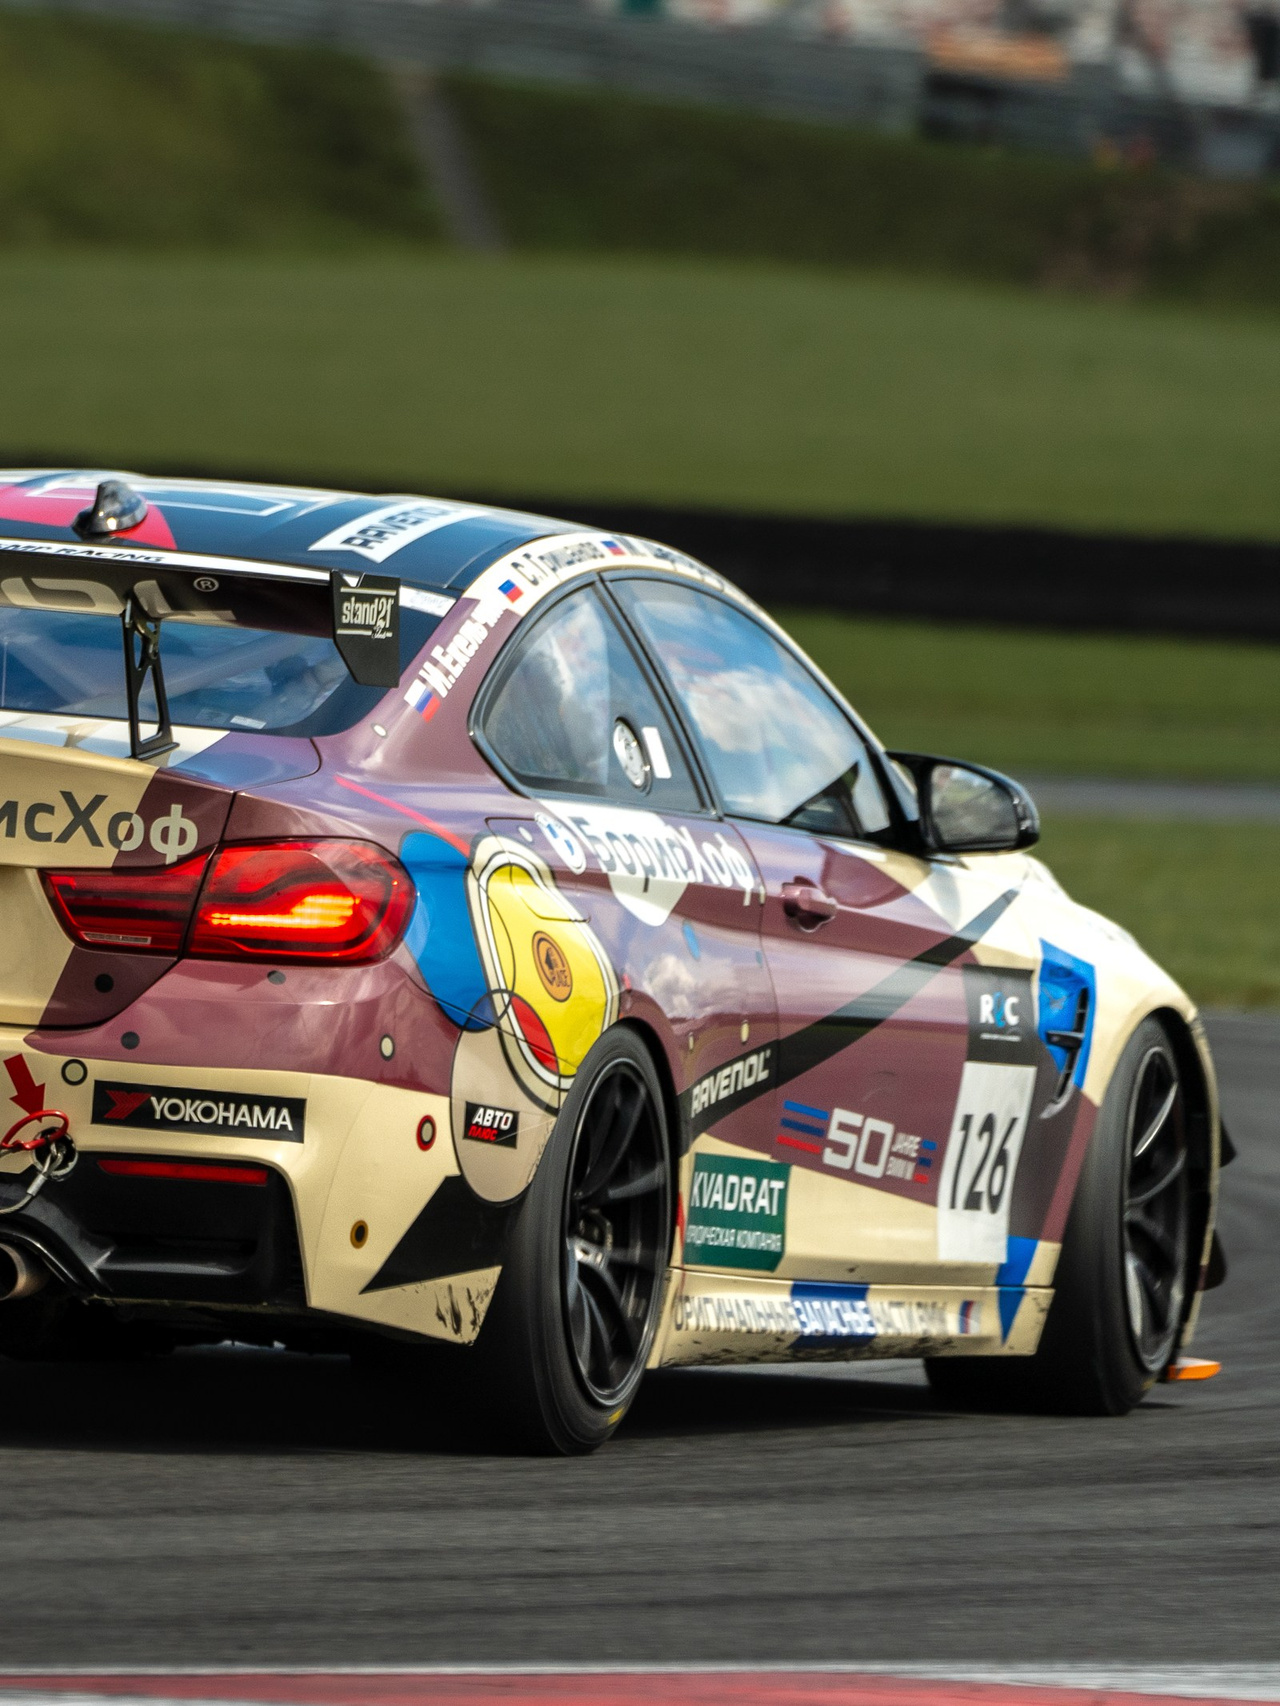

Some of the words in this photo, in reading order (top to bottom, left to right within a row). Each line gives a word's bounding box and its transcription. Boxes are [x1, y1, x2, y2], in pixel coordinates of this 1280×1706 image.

[340, 506, 461, 550] RAVENO
[56, 546, 167, 563] RACING
[151, 1095, 294, 1132] YOKOHAMA
[472, 1107, 514, 1131] АВТО
[822, 1107, 895, 1179] 50
[949, 1112, 1019, 1214] 126
[690, 1171, 785, 1216] KVADRAT
